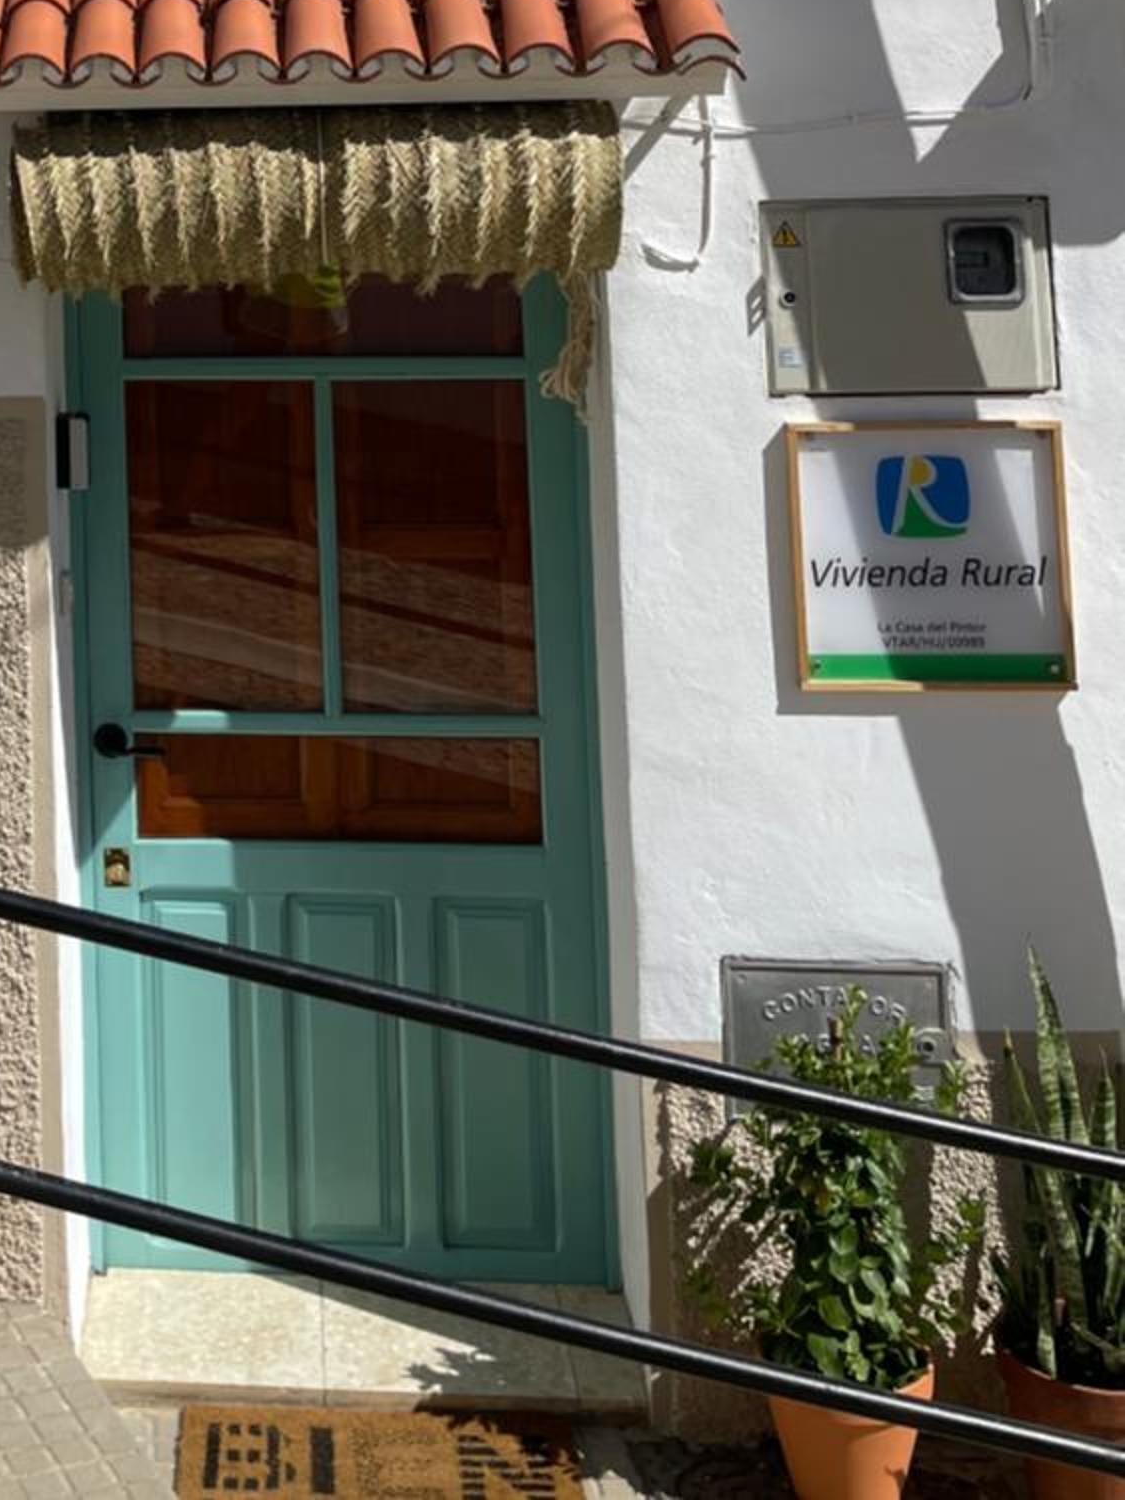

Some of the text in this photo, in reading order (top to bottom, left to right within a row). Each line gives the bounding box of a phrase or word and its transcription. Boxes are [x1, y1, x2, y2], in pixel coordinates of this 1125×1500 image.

[811, 555, 1047, 588] Vivienda Rural
[878, 622, 893, 633] La
[895, 621, 923, 633] Casa
[762, 984, 907, 1021] CONTAOR
